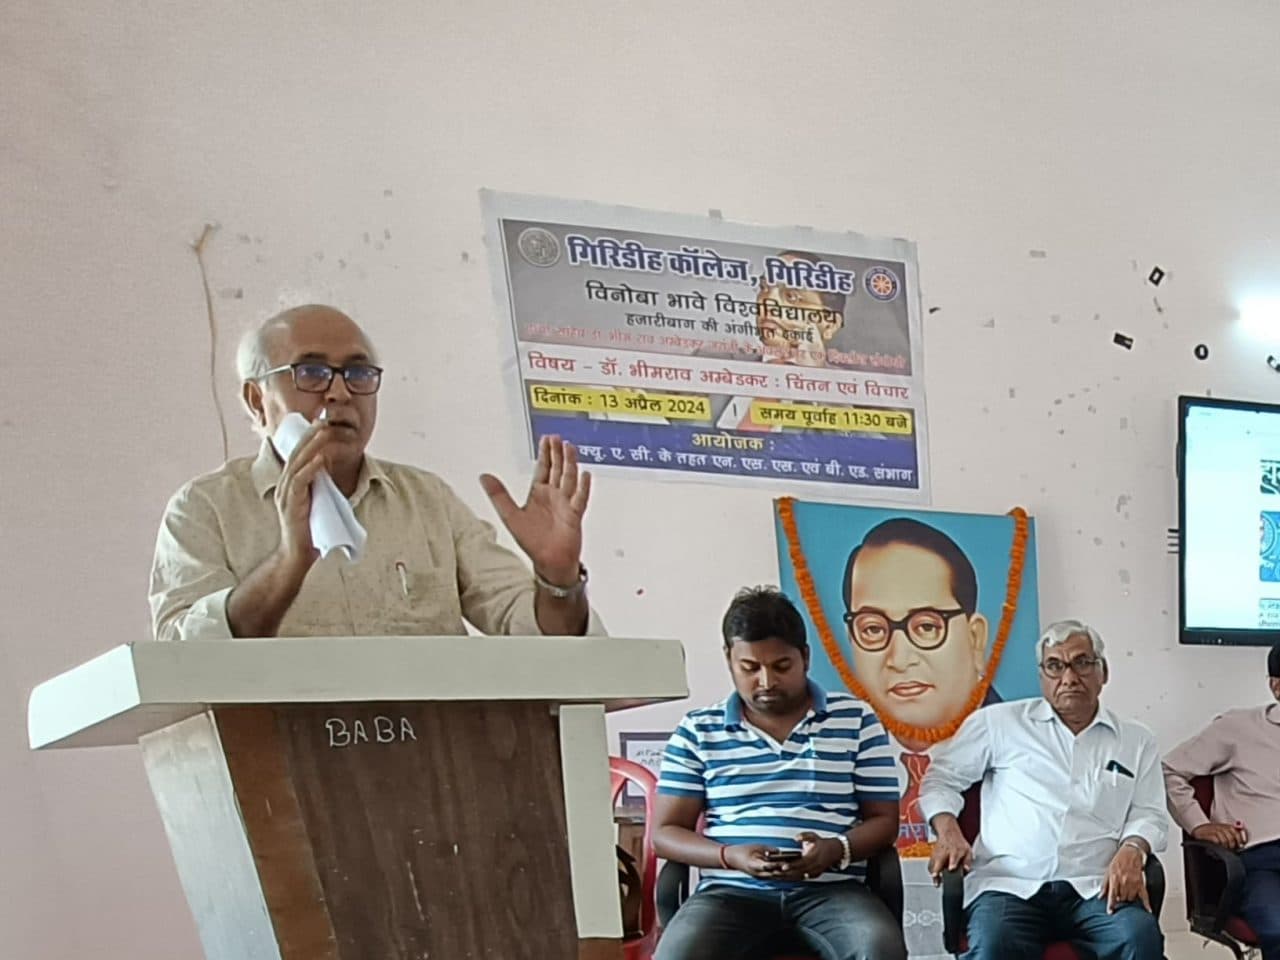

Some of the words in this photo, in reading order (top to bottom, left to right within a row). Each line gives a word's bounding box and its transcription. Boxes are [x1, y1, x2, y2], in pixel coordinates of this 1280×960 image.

[567, 236, 663, 271] गिरिडीह
[766, 257, 854, 292] गिरिडीह
[586, 280, 659, 307] विनोबा
[667, 291, 708, 312] भावे
[625, 312, 697, 331] हजारीबाग
[701, 317, 719, 333] की
[528, 351, 576, 371] विषय
[599, 357, 622, 377] डॉ.
[629, 360, 693, 381] भीमराव
[700, 368, 769, 388] अम्बेडकर
[837, 377, 858, 395] एवं
[865, 381, 910, 400] विचार
[533, 386, 582, 405] दिनांक
[601, 394, 619, 408] 13
[669, 400, 706, 414] 2024
[759, 407, 796, 421] समय
[844, 411, 881, 427] 11:30
[885, 414, 908, 430] बजे
[657, 448, 673, 462] के
[676, 452, 706, 466] तहत
[692, 431, 764, 451] आयोजक
[325, 716, 417, 748] BABA
